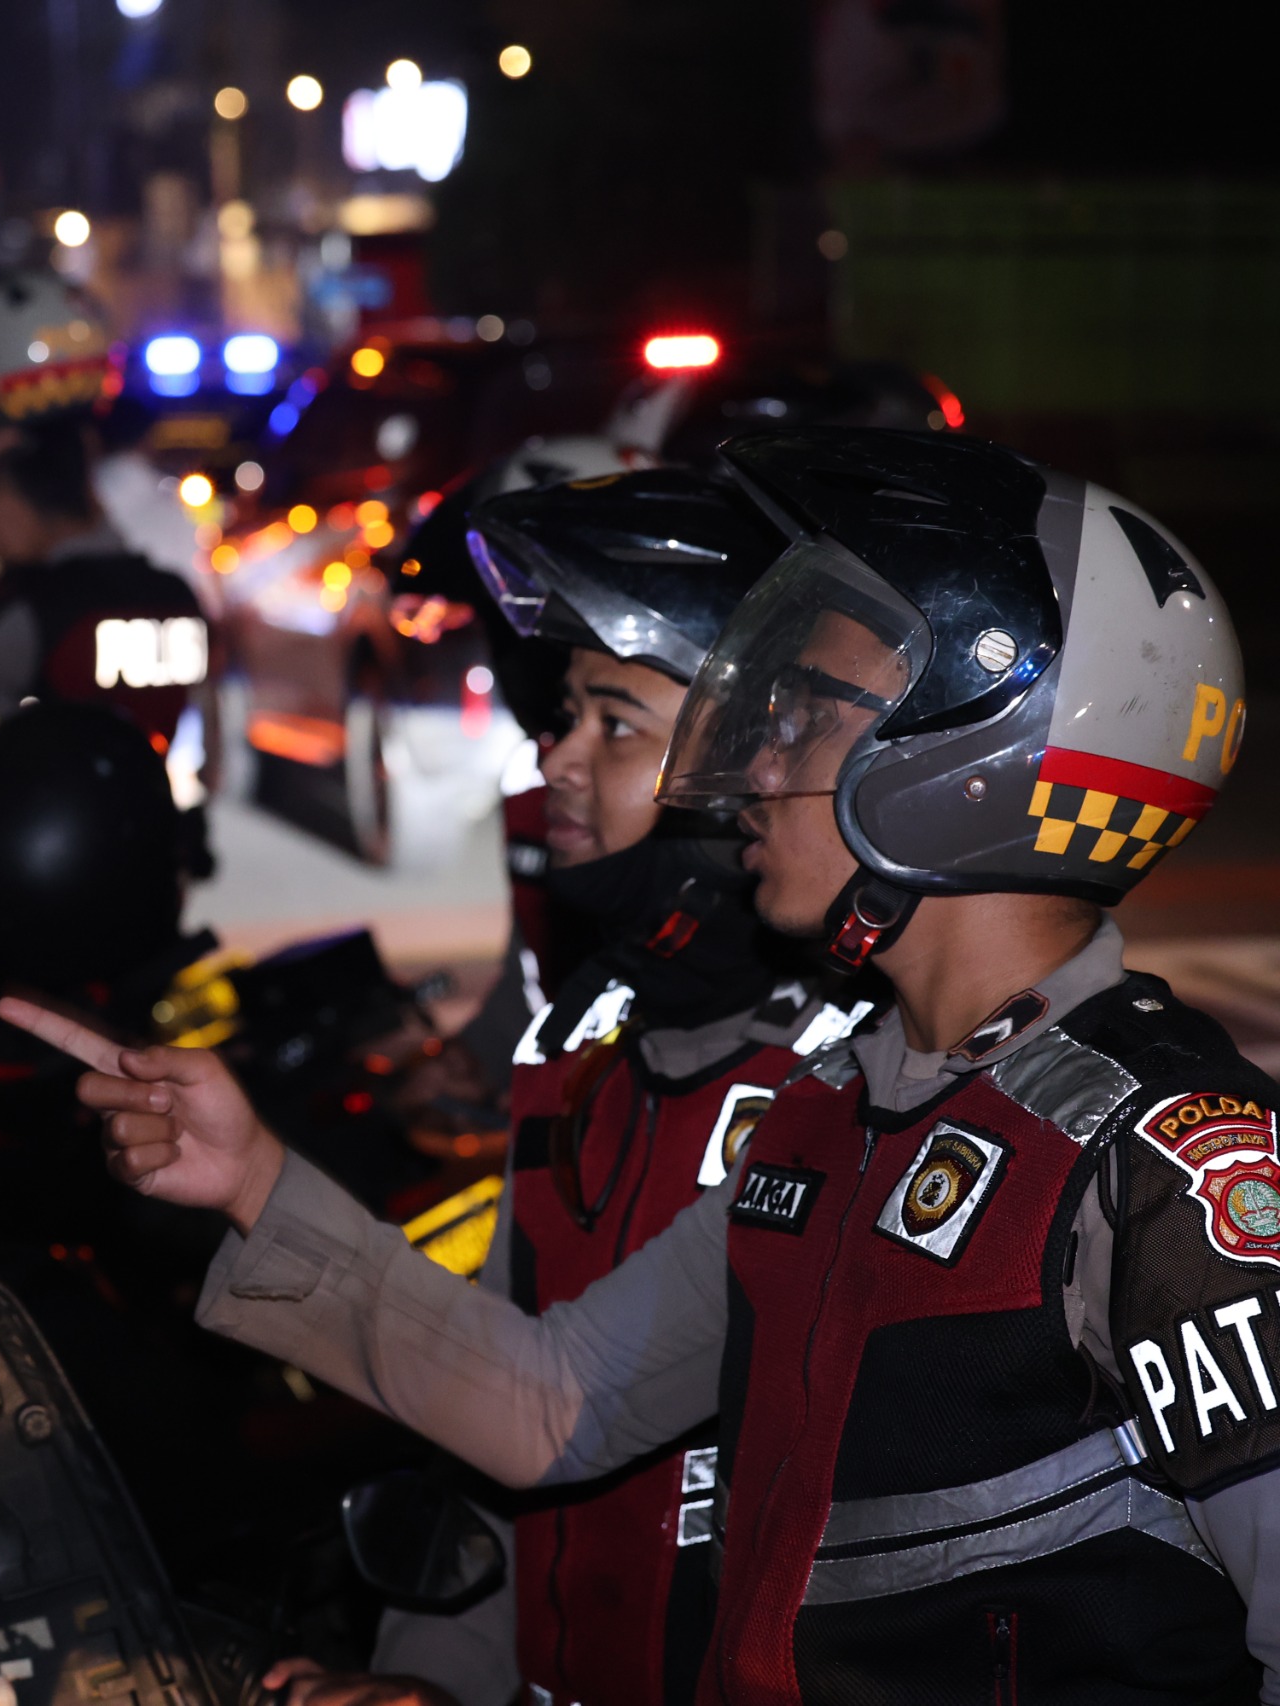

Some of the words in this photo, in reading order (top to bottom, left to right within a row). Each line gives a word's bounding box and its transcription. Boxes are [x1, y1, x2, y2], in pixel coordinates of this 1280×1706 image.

[1159, 1096, 1263, 1139] POLDA
[1186, 1135, 1232, 1161] METRO
[1129, 1289, 1280, 1453] PAT
